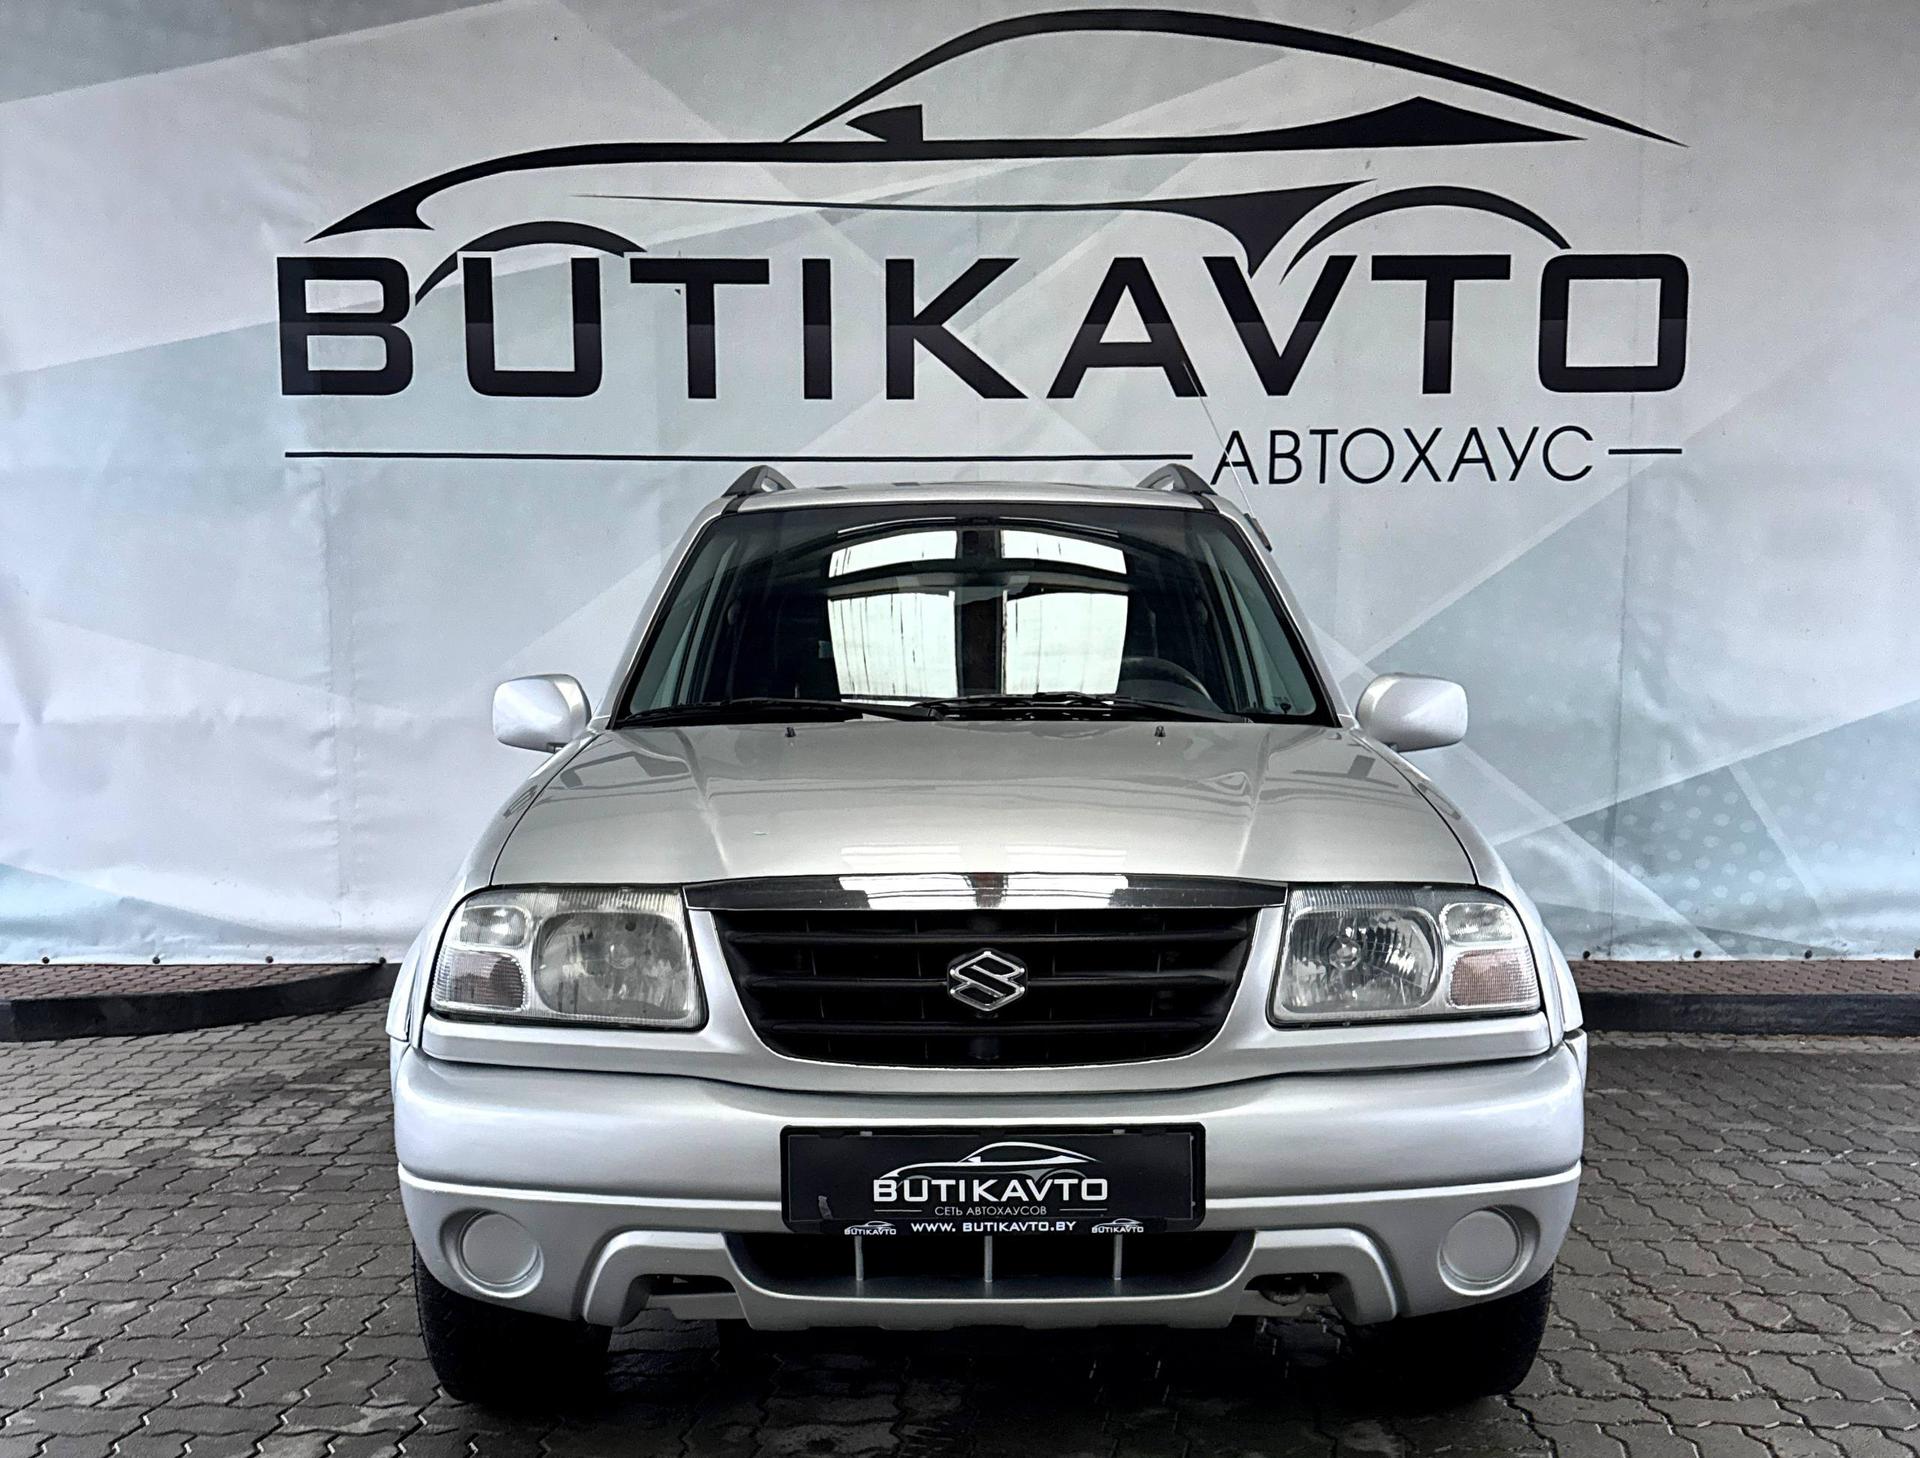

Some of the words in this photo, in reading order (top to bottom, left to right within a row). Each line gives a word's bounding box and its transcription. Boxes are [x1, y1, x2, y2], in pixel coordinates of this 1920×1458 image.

[277, 253, 1690, 400] BUTIKAVTO
[1210, 425, 1594, 486] АВТОХАУС
[873, 1178, 1108, 1202] BUTIKAVTO
[934, 1206, 963, 1216] СЕТЬ
[966, 1205, 1047, 1216] АВТОХАУСОВ
[844, 1228, 897, 1236] BUTIKAVTO
[1091, 1225, 1144, 1234] BUTIKAVTO
